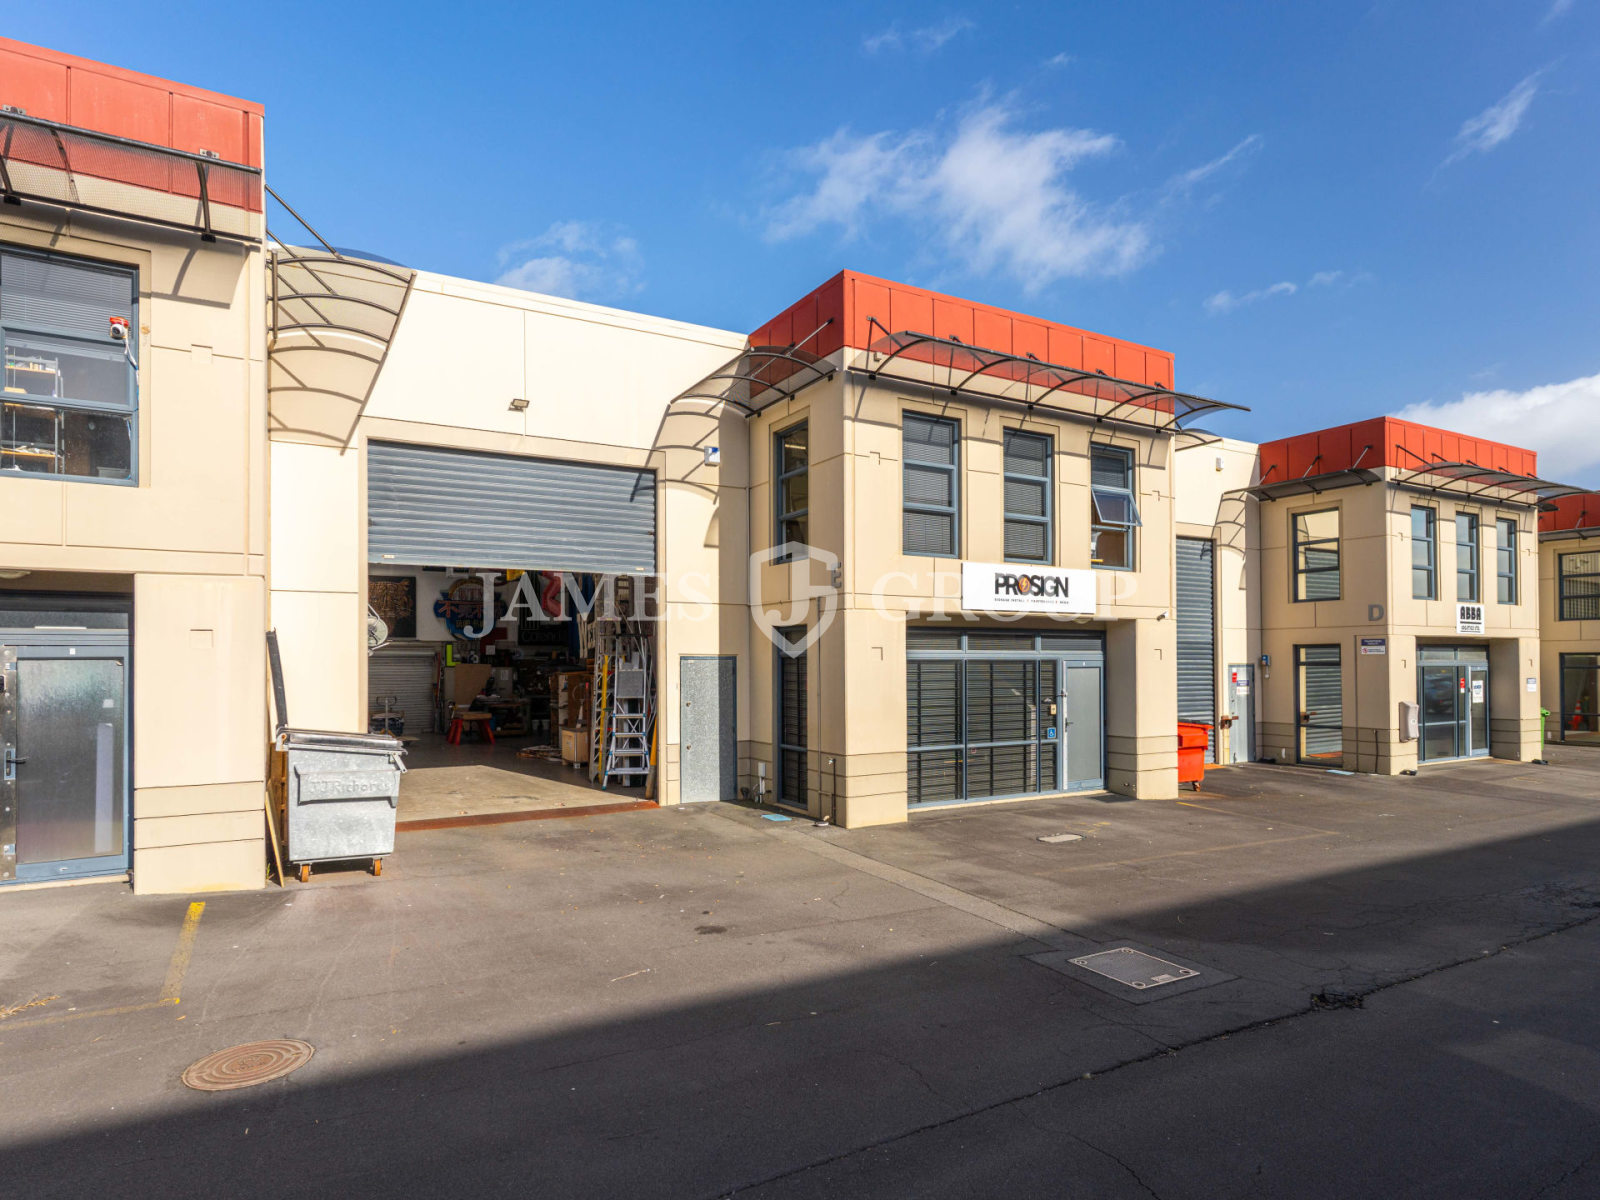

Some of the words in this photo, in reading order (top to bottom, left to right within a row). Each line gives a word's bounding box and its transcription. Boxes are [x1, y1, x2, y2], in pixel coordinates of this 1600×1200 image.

[994, 572, 1069, 598] PROSIGN
[1367, 604, 1385, 622] D
[1460, 605, 1482, 621] ABBA
